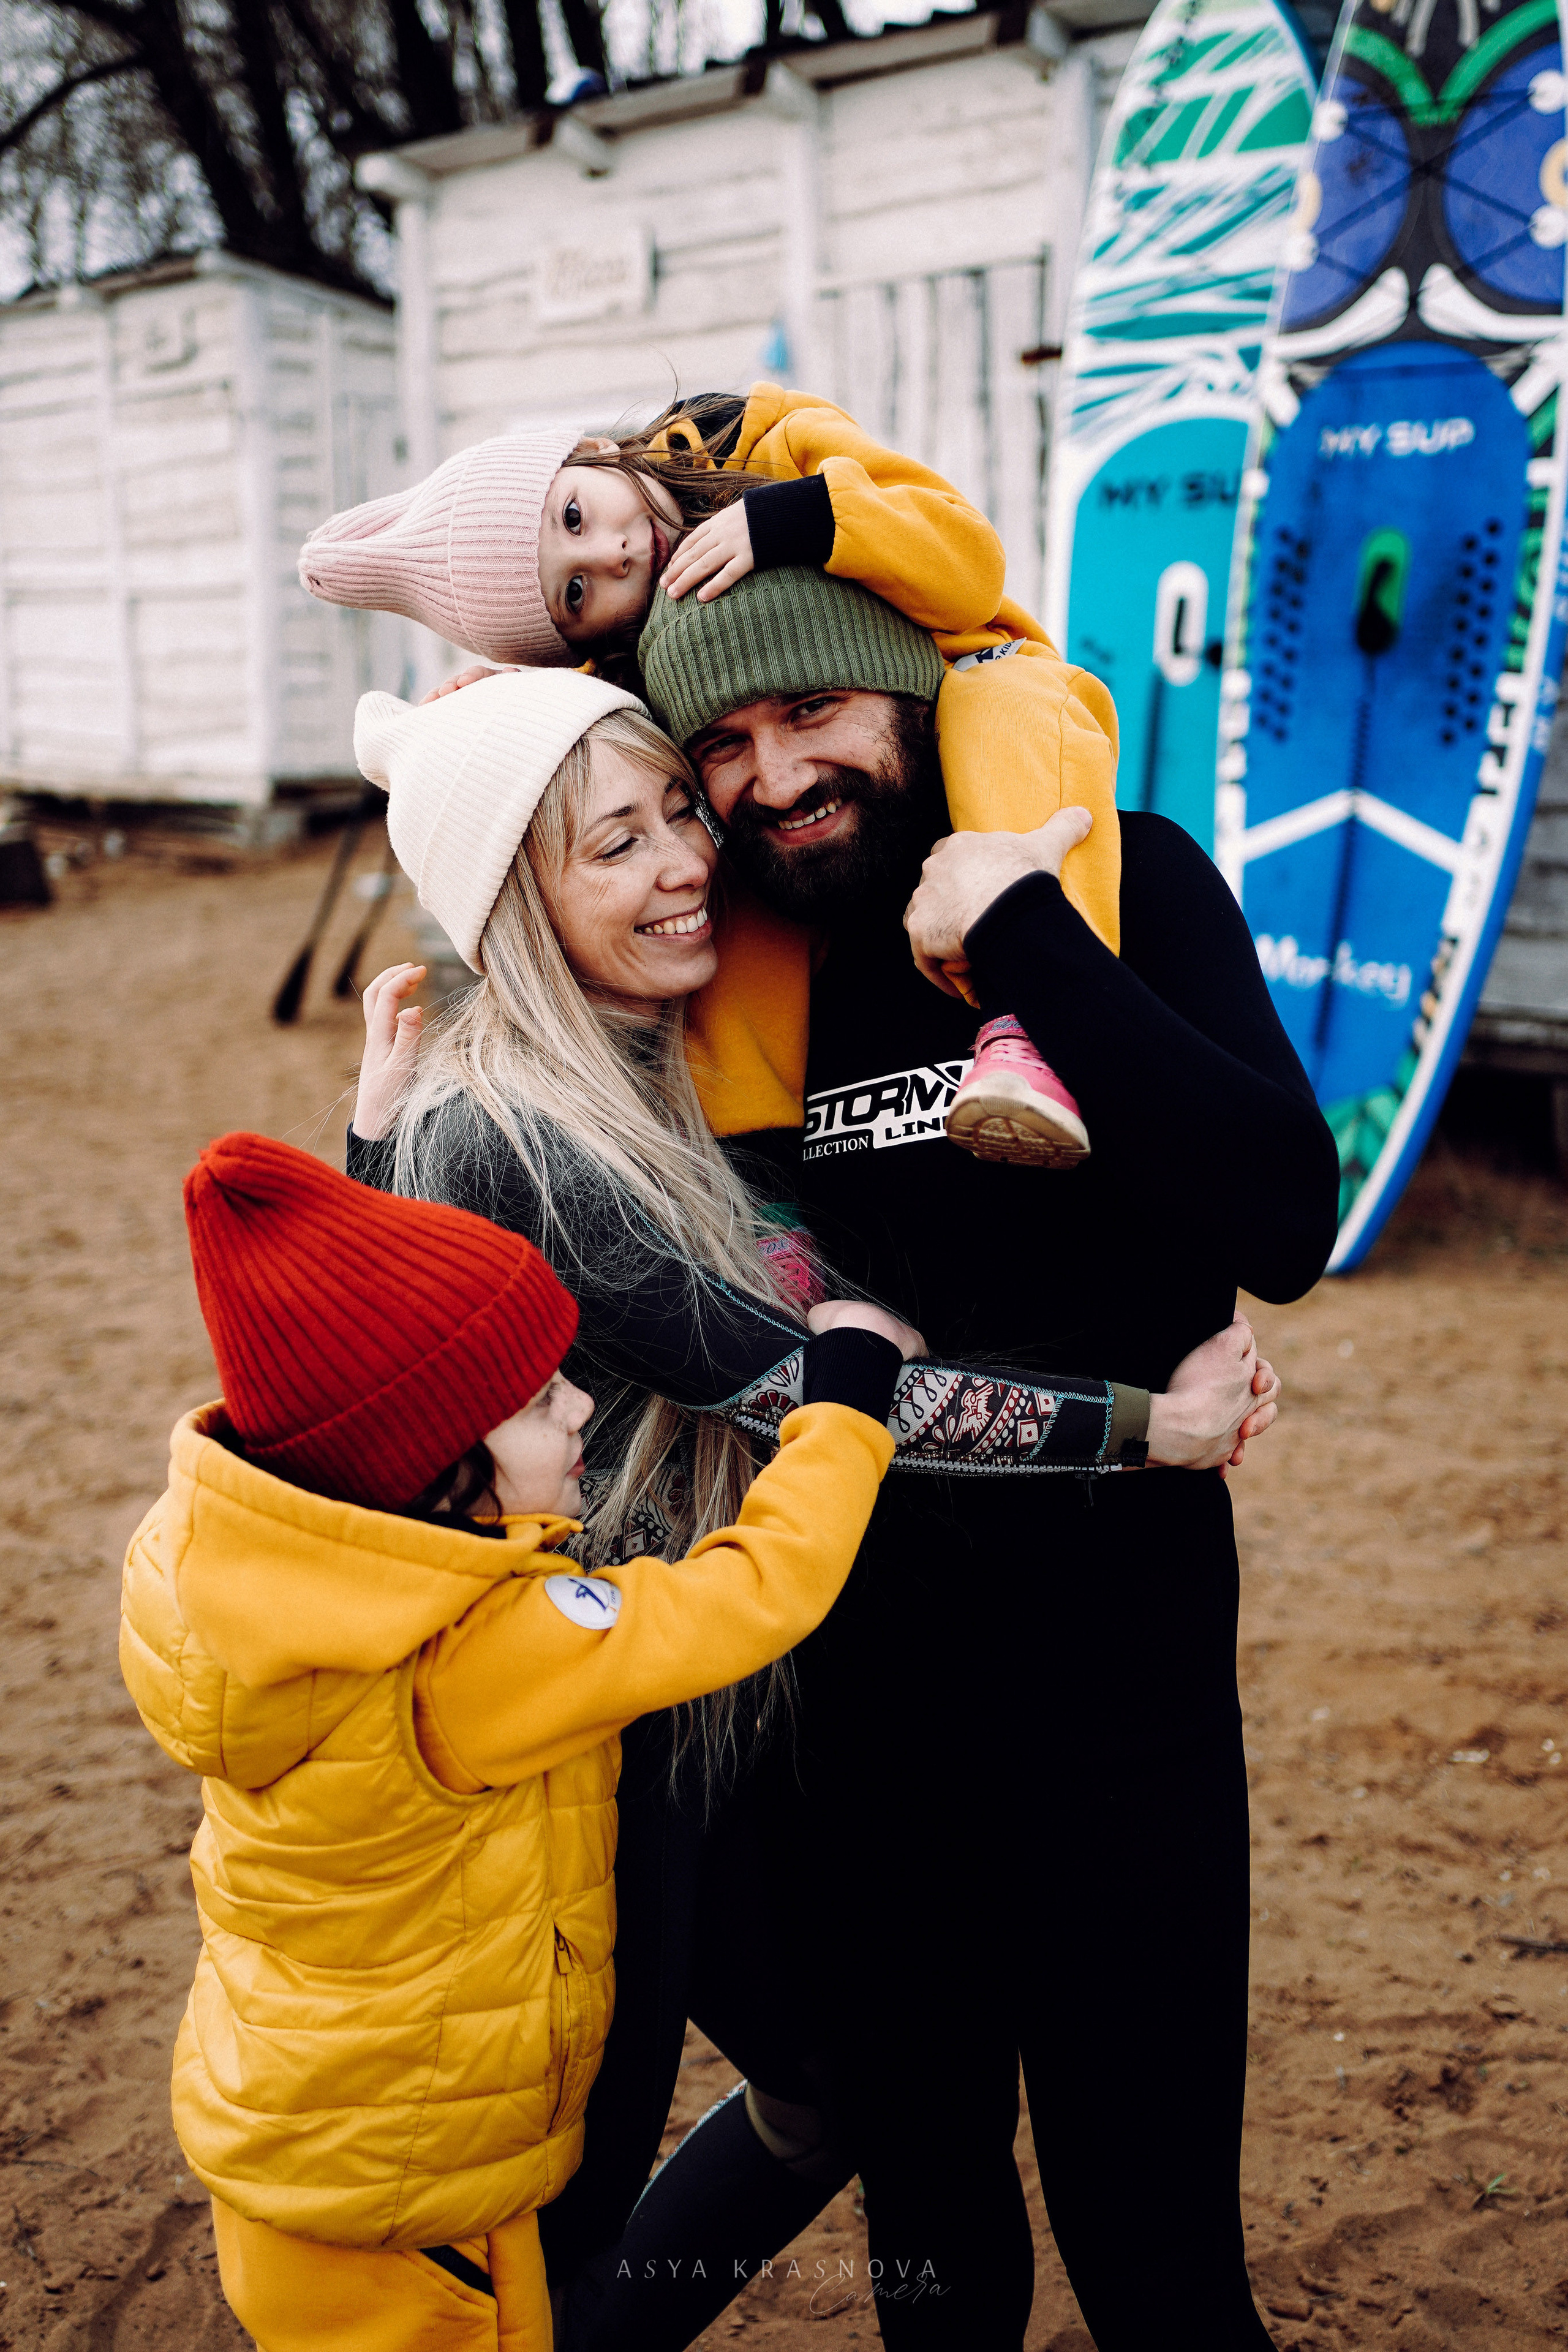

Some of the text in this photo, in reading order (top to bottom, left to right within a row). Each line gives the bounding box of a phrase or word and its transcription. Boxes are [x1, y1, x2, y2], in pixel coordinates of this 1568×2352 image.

[1319, 417, 1475, 459] MY SUP
[1183, 469, 1241, 511] SU
[884, 1115, 947, 1140] LIN
[803, 1136, 869, 1161] LLECTION
